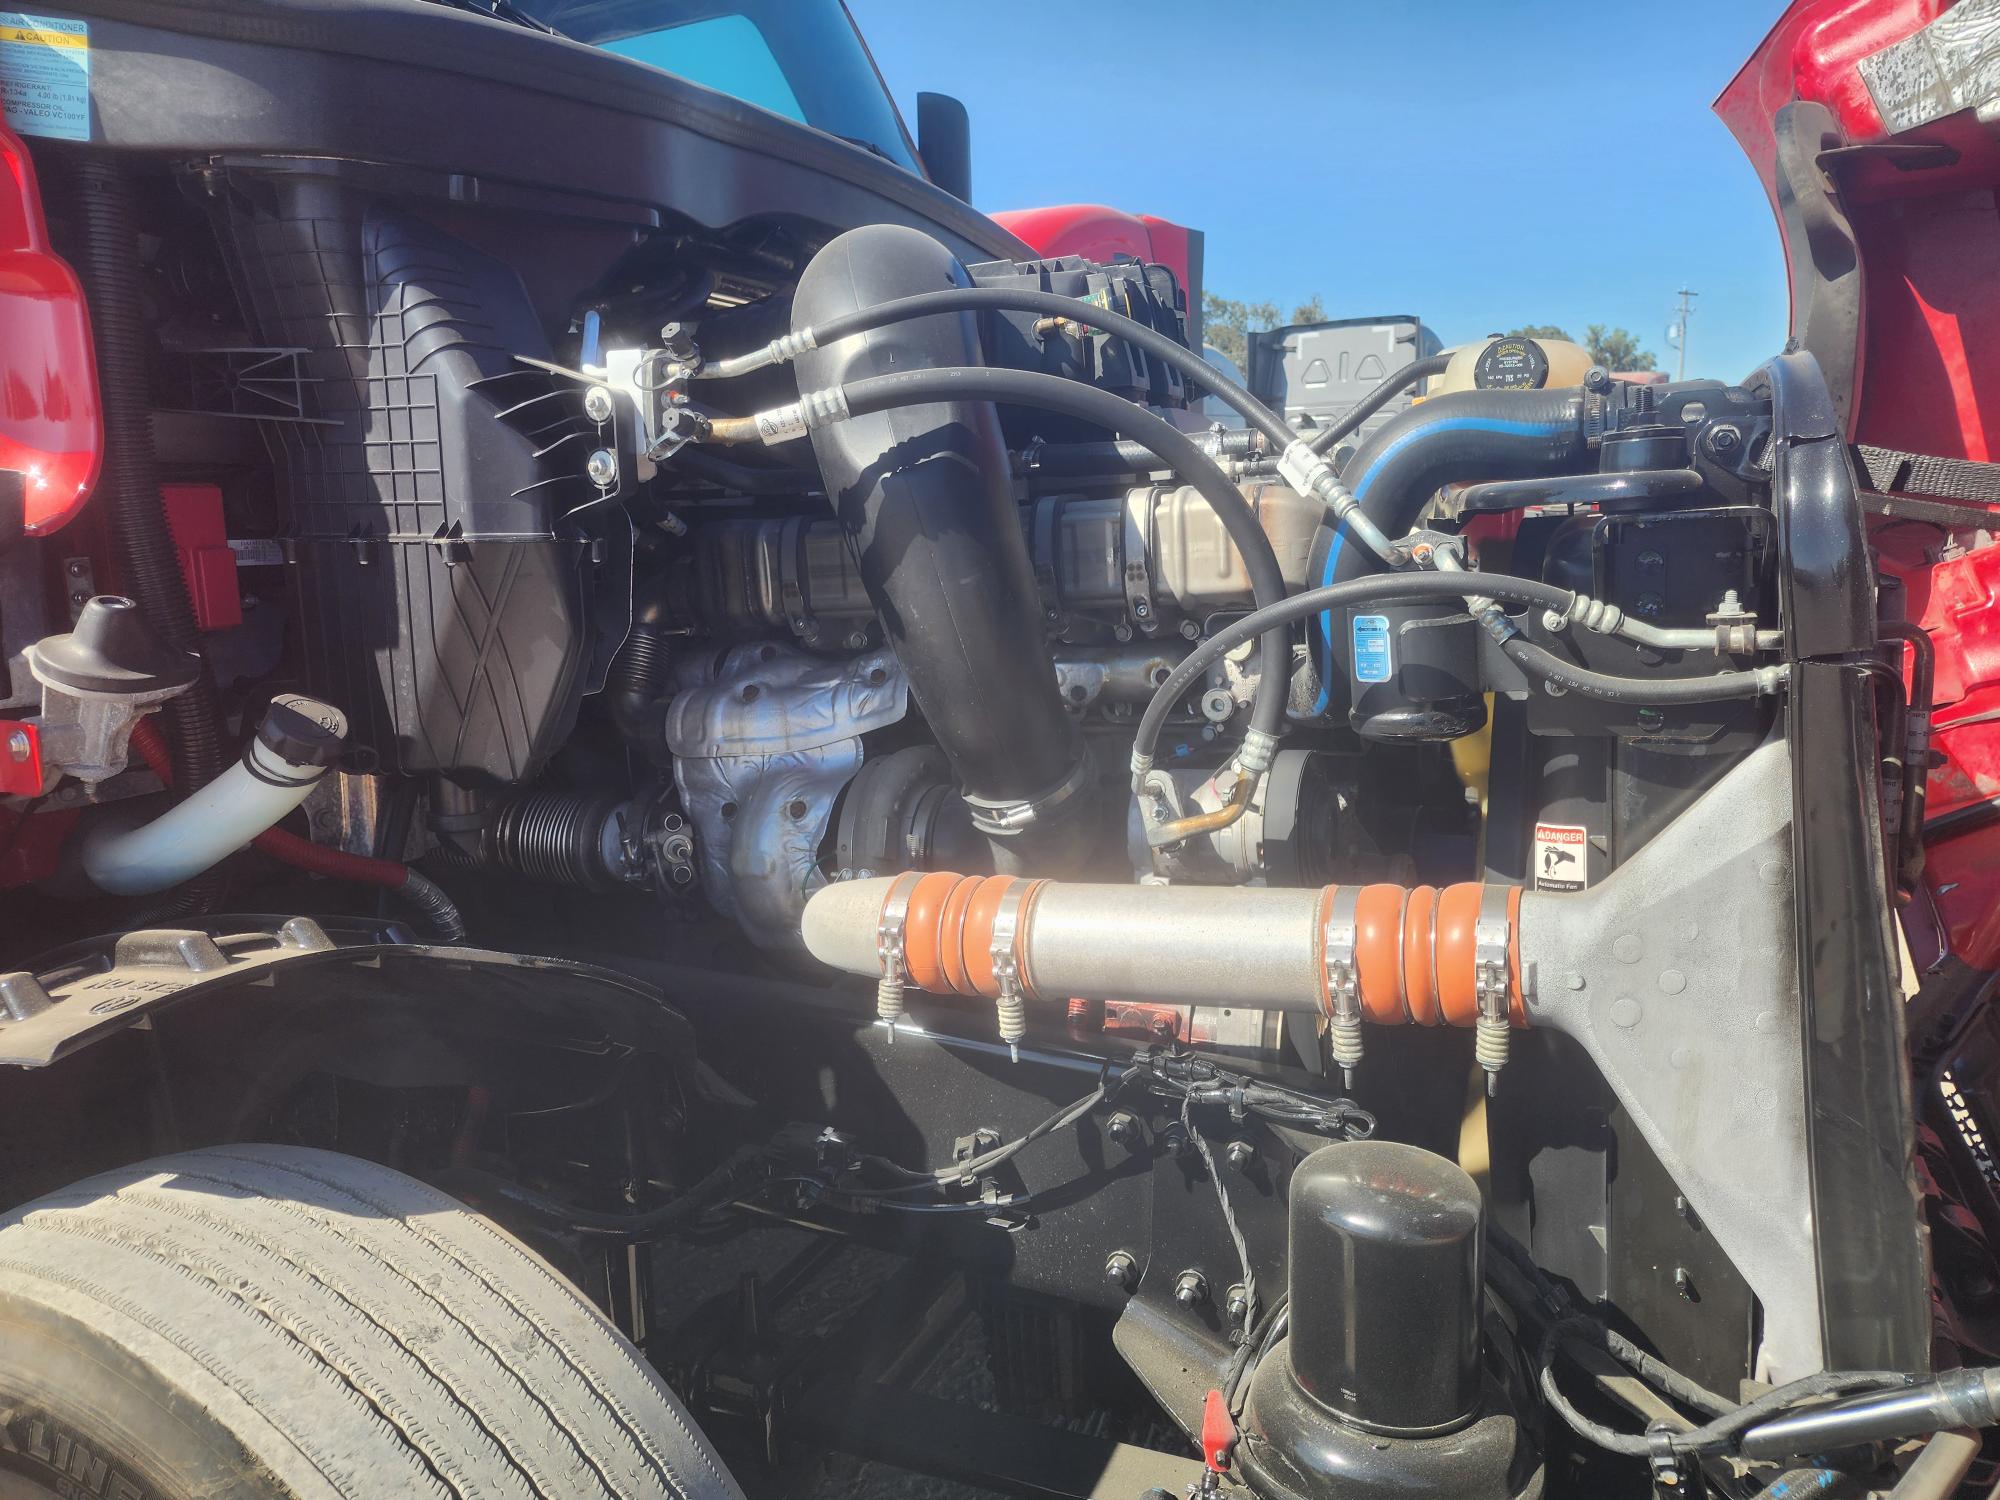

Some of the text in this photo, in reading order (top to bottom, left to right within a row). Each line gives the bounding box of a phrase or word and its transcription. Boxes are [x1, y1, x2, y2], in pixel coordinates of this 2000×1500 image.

[10, 17, 84, 33] AIR CONDITIONER
[26, 32, 70, 45] CAUTION
[1, 98, 52, 110] COMPRESSOR
[24, 109, 50, 118] VALEO
[1502, 343, 1525, 351] CAUTION
[1545, 831, 1584, 842] DANGER
[1538, 880, 1566, 889] Automatic
